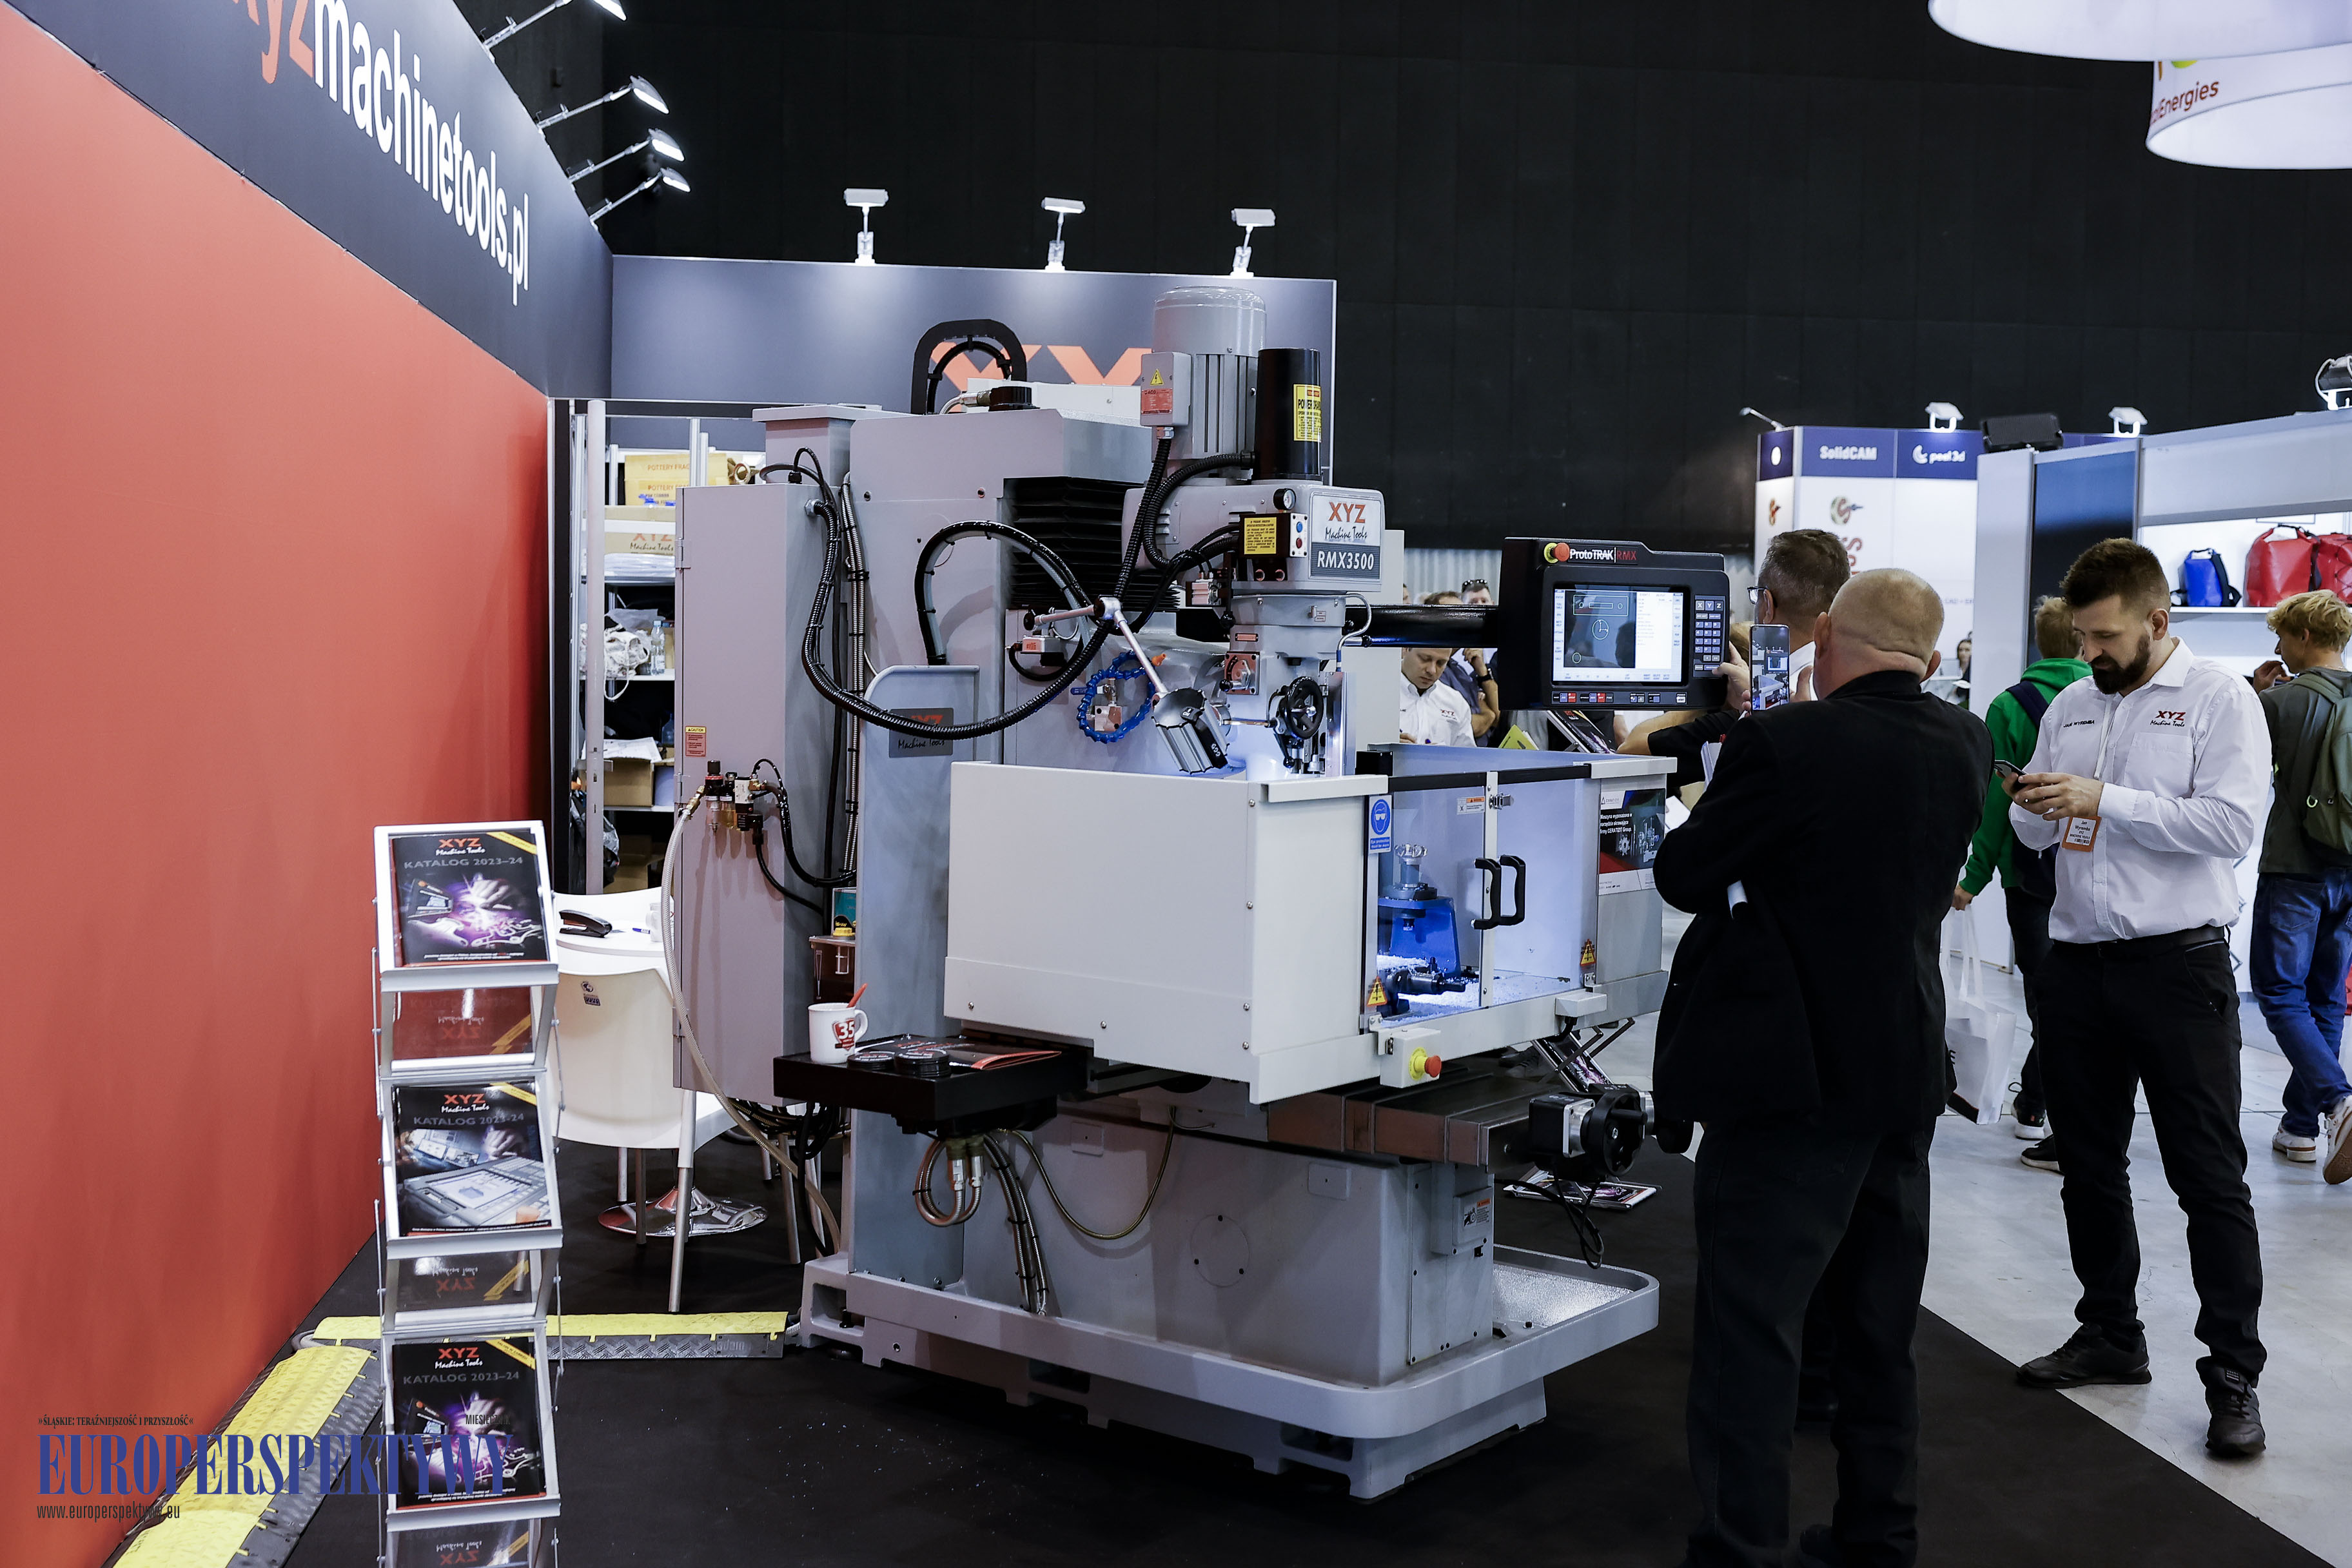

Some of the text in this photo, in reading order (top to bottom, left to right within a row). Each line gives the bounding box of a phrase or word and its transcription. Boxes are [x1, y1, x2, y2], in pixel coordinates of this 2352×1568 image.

[2150, 81, 2220, 125] Energies
[232, 0, 529, 306] yzmachinetools.pl
[1819, 445, 1877, 461] SolidCAM
[1328, 502, 1367, 524] XYZ
[1325, 525, 1368, 540] Machine Tools
[630, 542, 674, 551] Machine Tools
[1317, 550, 1375, 570] RMX3500
[1569, 549, 1636, 560] ProtoTRAK RMX
[2155, 710, 2186, 721] XYZ
[898, 738, 926, 749] Machine
[439, 838, 482, 848] XYZ
[404, 859, 469, 868] KATALOG
[838, 1021, 855, 1040] 35
[444, 1093, 486, 1104] XYZ
[413, 1117, 476, 1125] KATALOG
[438, 1347, 480, 1359] XYZ
[435, 1358, 483, 1369] Machine Tools
[403, 1373, 467, 1384] KATALOG
